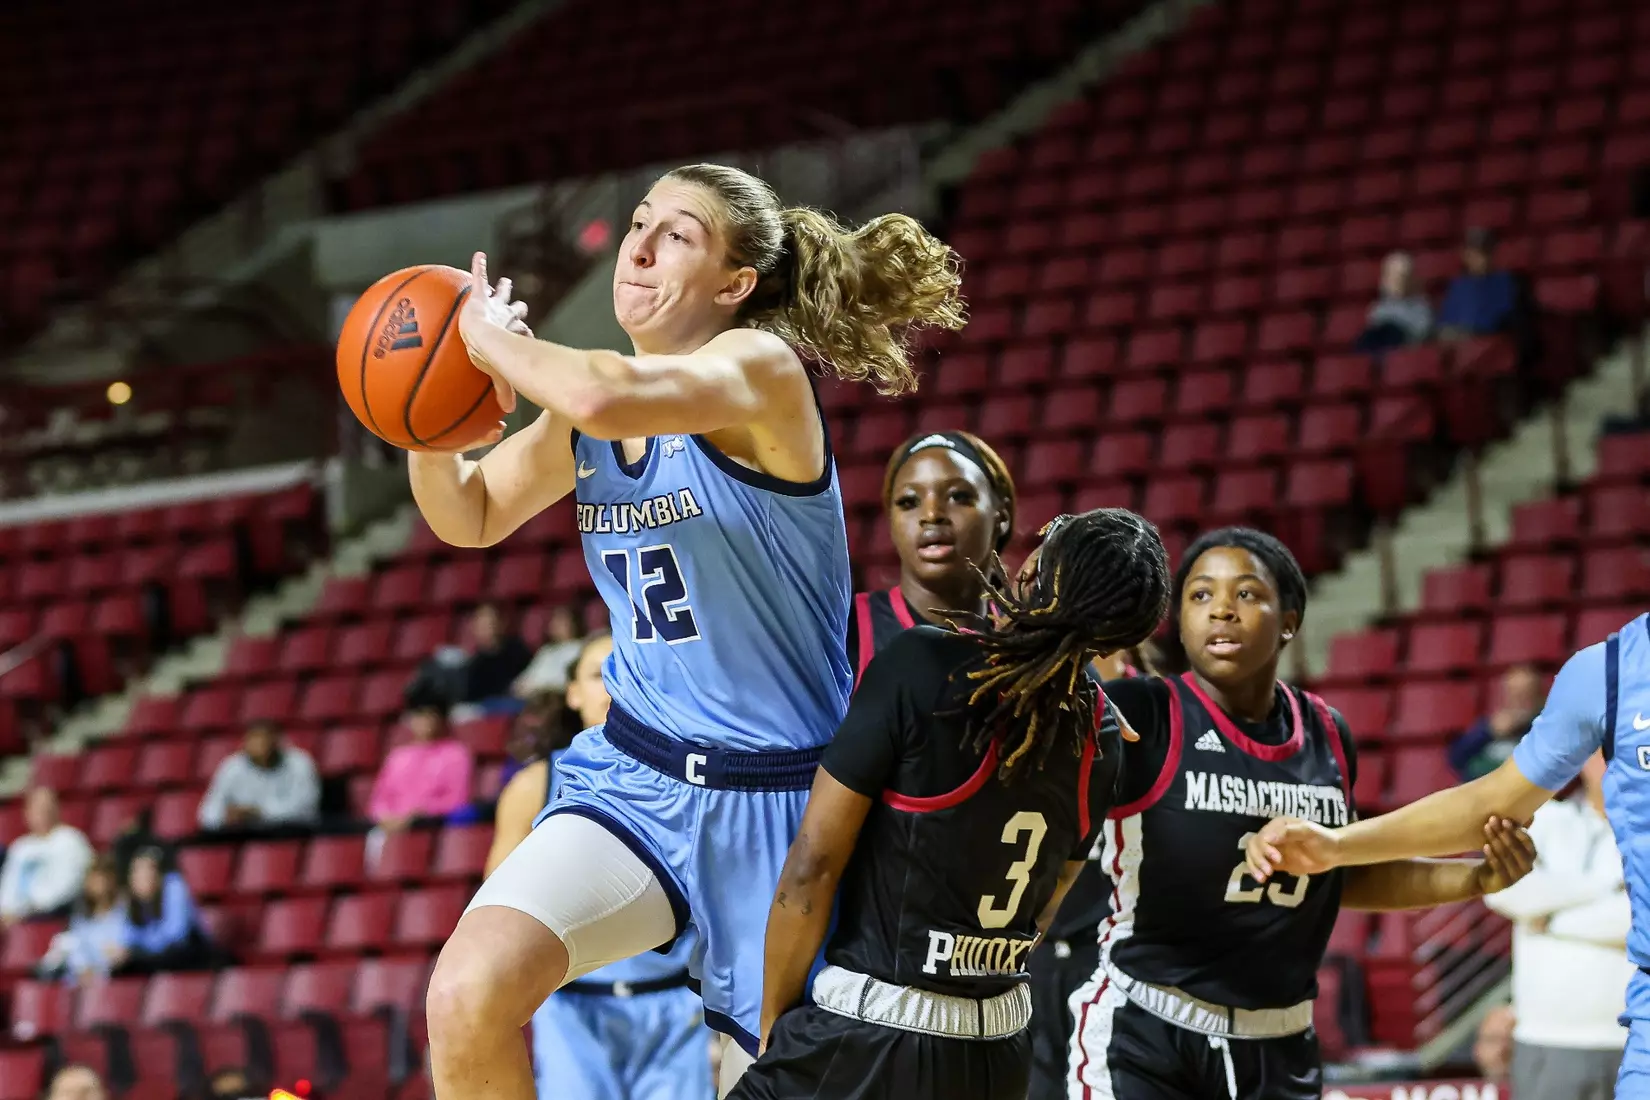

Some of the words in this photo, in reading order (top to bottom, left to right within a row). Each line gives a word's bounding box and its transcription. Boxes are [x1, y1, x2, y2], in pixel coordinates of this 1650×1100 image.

[373, 298, 411, 359] adidas
[601, 544, 701, 645] 12
[685, 753, 707, 785] C
[1184, 770, 1348, 826] MASSACHUSETTS
[977, 811, 1048, 929] 3
[922, 929, 1033, 977] PHILOX
